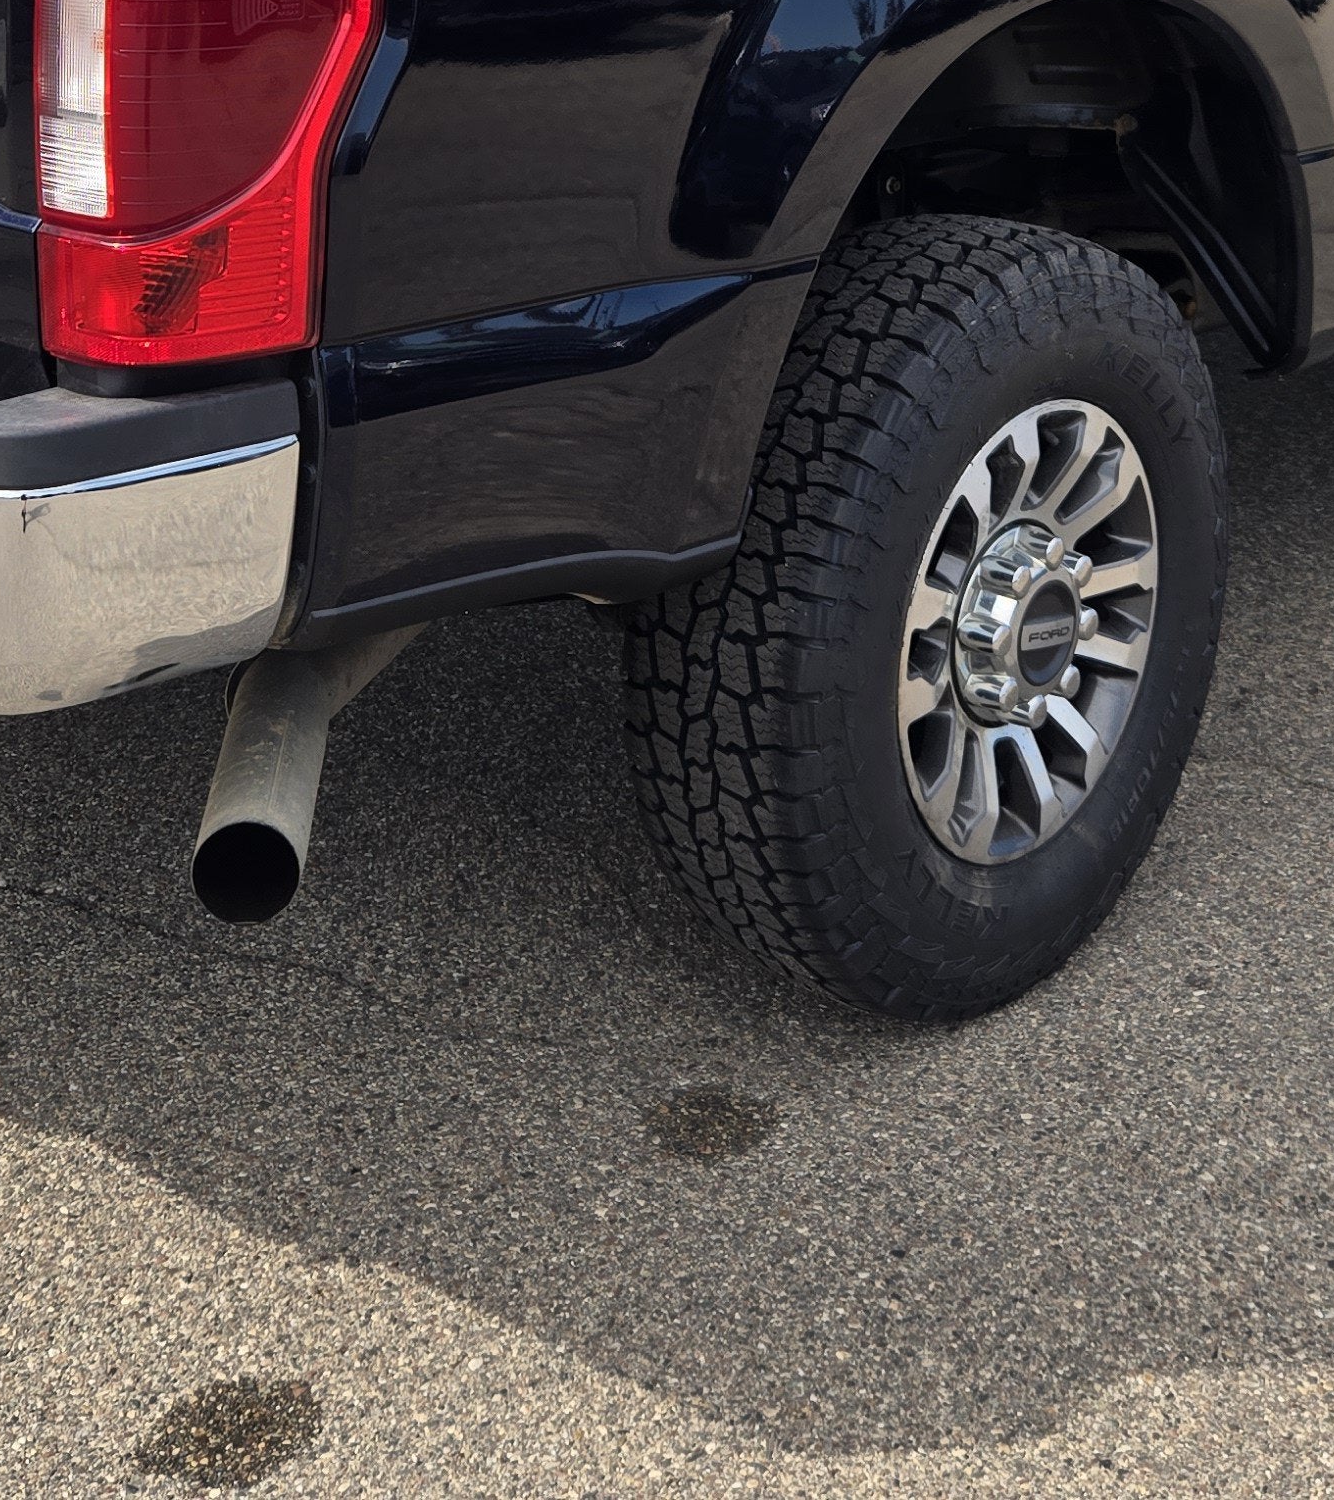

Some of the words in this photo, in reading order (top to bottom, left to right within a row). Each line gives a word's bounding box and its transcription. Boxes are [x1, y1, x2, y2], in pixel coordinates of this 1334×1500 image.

[1092, 341, 1194, 445] KELLY
[1028, 626, 1071, 643] FORD
[893, 846, 1010, 942] KELLY
